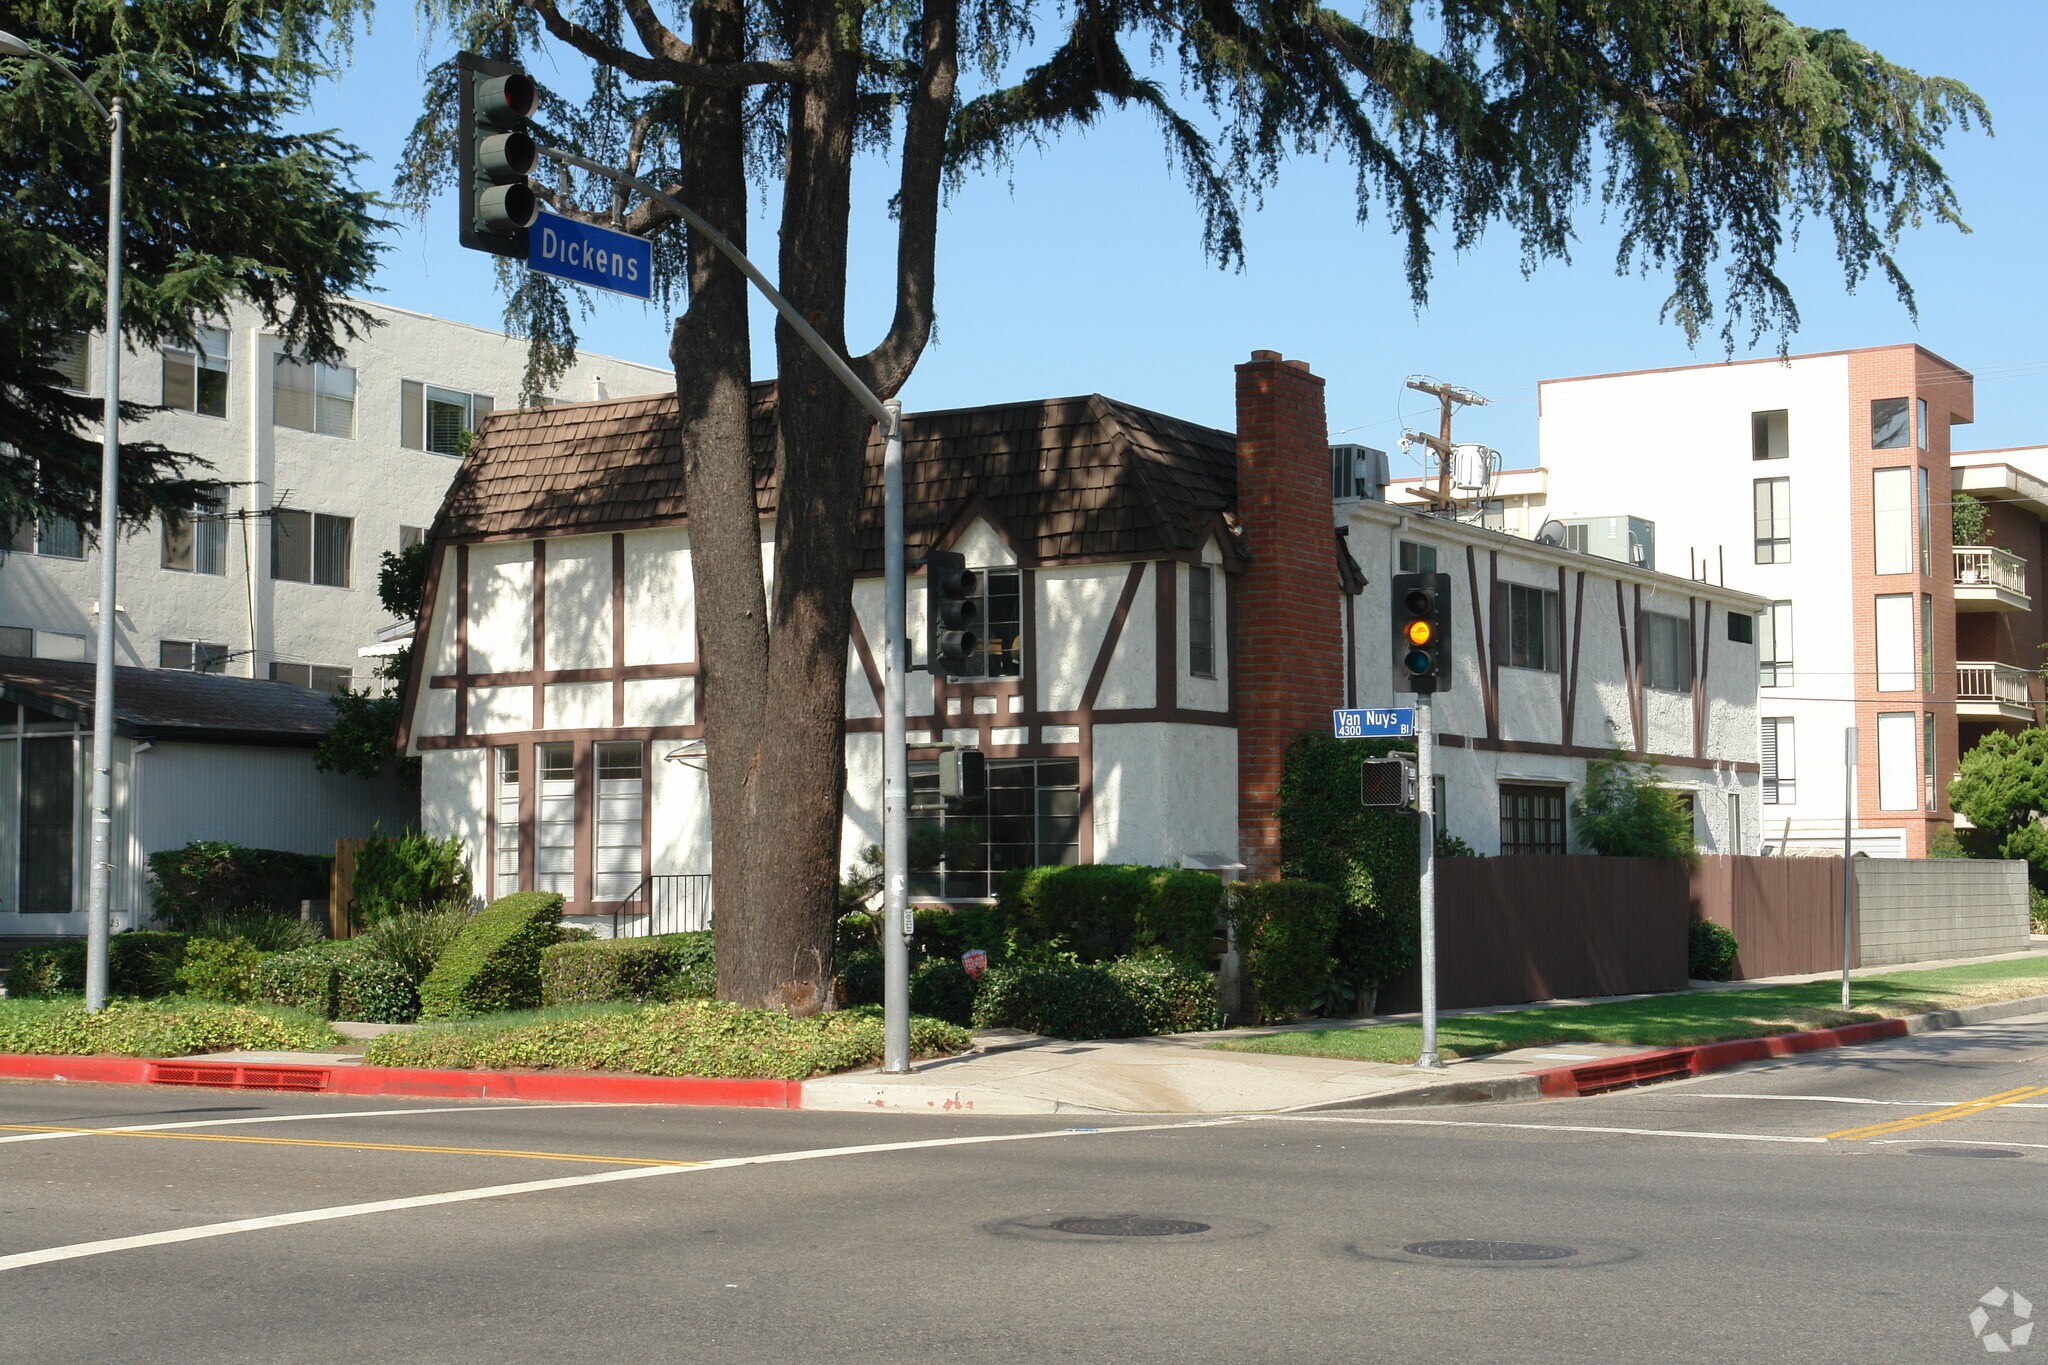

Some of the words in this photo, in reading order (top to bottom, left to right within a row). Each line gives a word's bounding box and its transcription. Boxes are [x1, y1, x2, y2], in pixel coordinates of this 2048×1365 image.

[542, 228, 638, 281] Dickens
[1338, 711, 1361, 726] Van
[1366, 710, 1397, 729] Nuys
[1338, 725, 1361, 736] 4300
